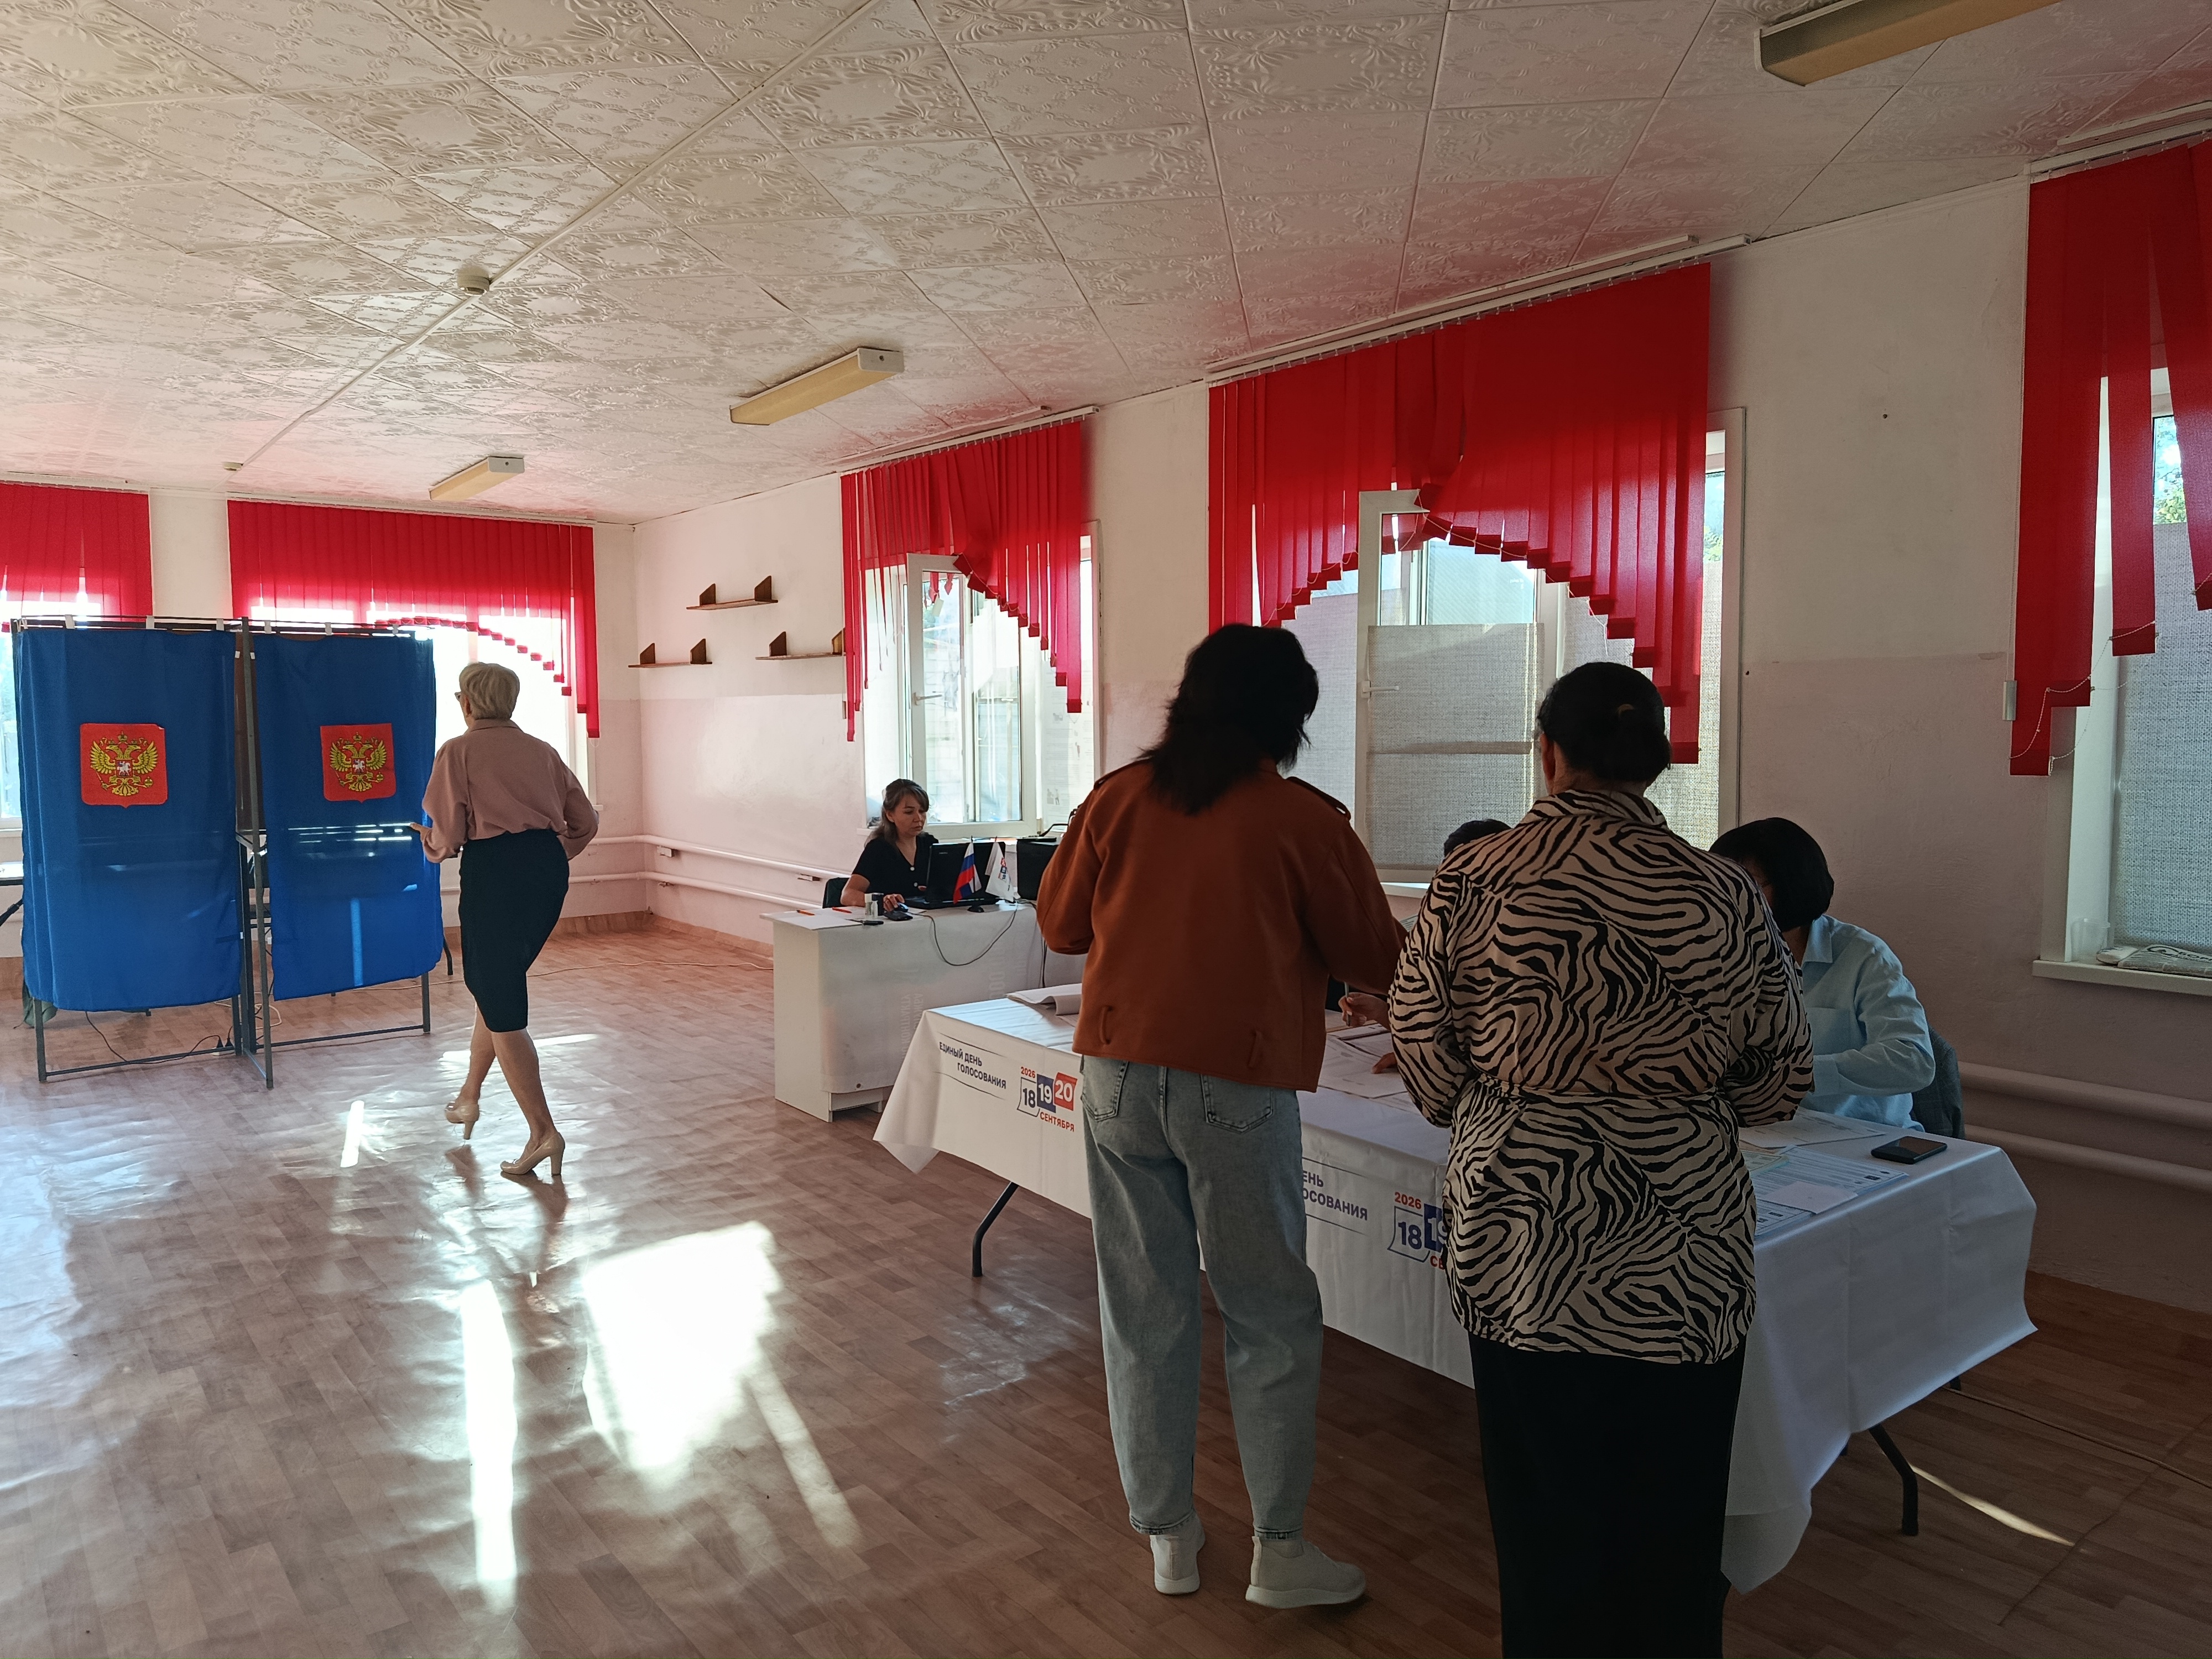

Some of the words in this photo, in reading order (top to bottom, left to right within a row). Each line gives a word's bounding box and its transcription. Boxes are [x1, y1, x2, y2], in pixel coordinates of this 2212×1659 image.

[940, 1041, 963, 1060] ЕДИНЫЙ
[964, 1052, 982, 1067] ДЕНЬ
[957, 1062, 1006, 1089] ГОЛОСОВАНИЯ
[1020, 1066, 1036, 1078] 2026
[1022, 1088, 1036, 1108] 18
[1038, 1083, 1052, 1104] 19
[1055, 1079, 1073, 1102] 20
[1040, 1112, 1074, 1133] СЕНТЯБРЯ
[1302, 1170, 1324, 1187] ЕНЬ
[1302, 1187, 1368, 1221] ОСОВАНИЯ
[1394, 1192, 1422, 1210] 2026
[1398, 1221, 1422, 1250] 18
